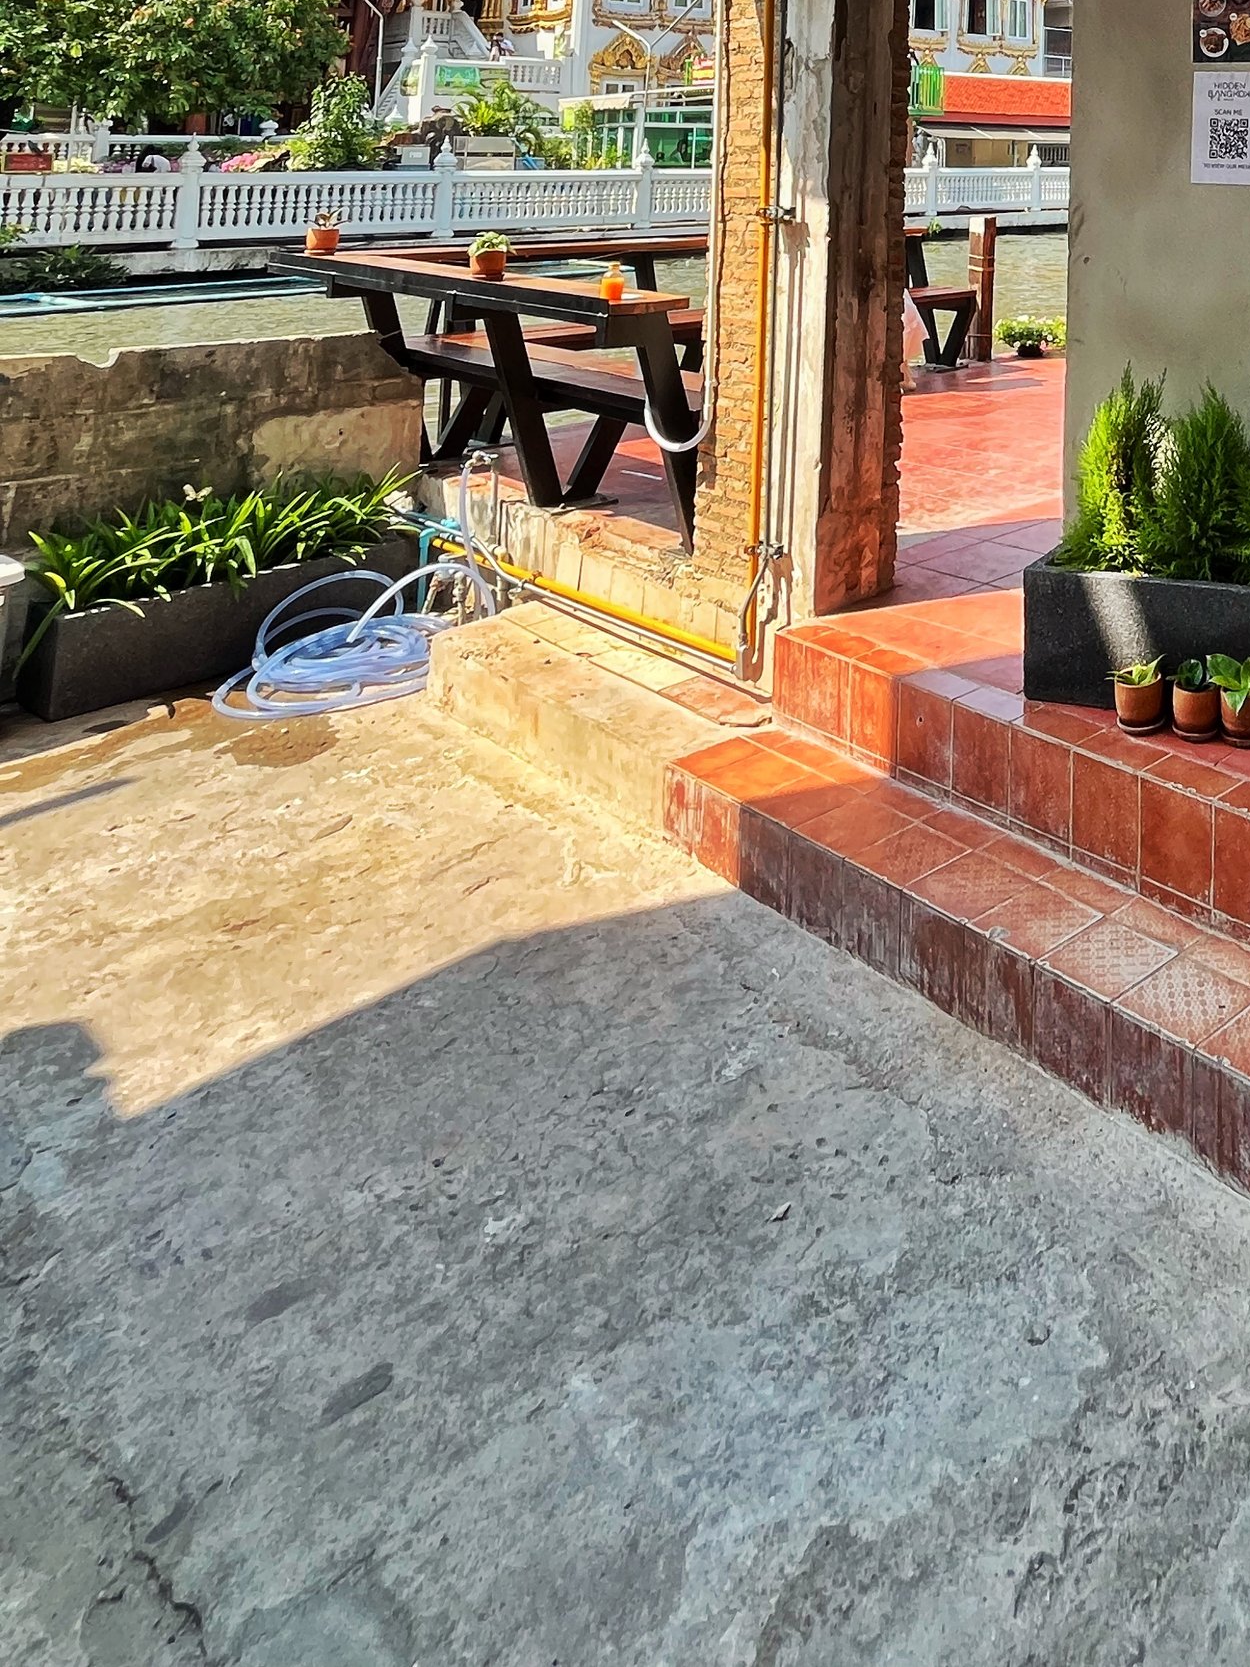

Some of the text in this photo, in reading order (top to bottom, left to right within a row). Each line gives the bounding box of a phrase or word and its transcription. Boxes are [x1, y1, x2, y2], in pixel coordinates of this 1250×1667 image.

[1213, 81, 1247, 90] HIDDEN
[1207, 89, 1250, 102] BANGKOK
[1214, 108, 1232, 116] SCAN
